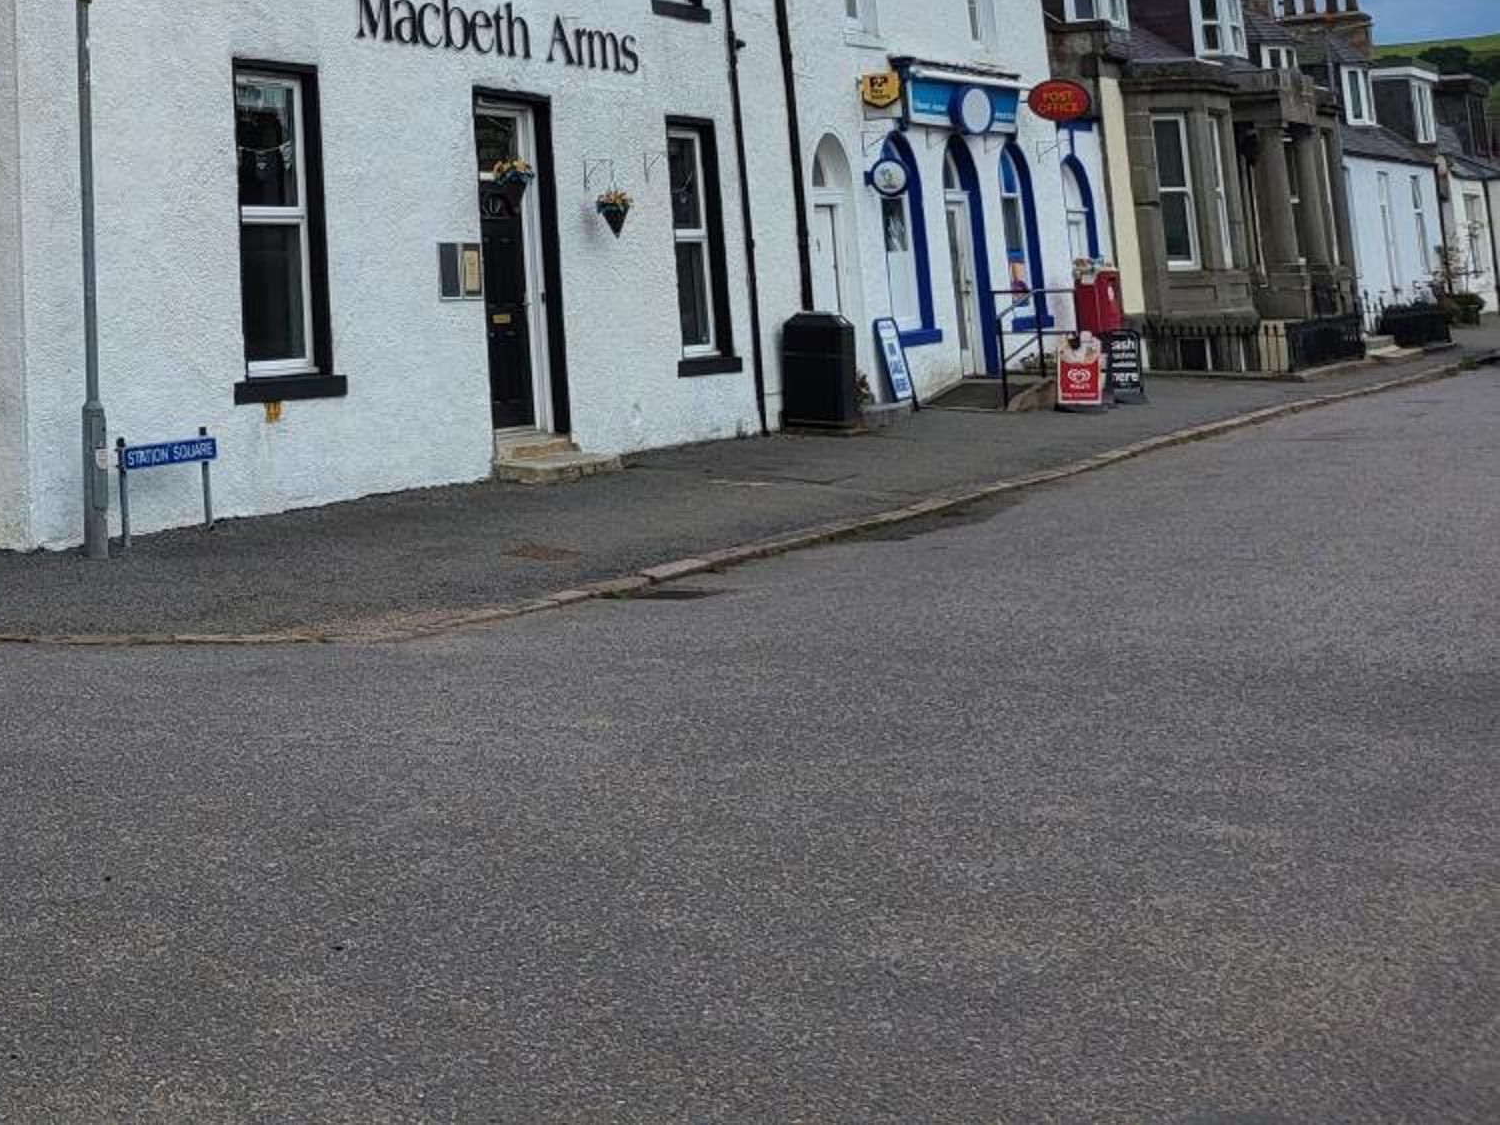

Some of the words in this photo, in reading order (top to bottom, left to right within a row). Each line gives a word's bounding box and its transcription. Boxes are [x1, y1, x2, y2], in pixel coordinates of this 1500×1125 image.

[546, 14, 640, 75] Arms
[127, 448, 169, 467] STATION
[173, 442, 214, 460] SQUARE
